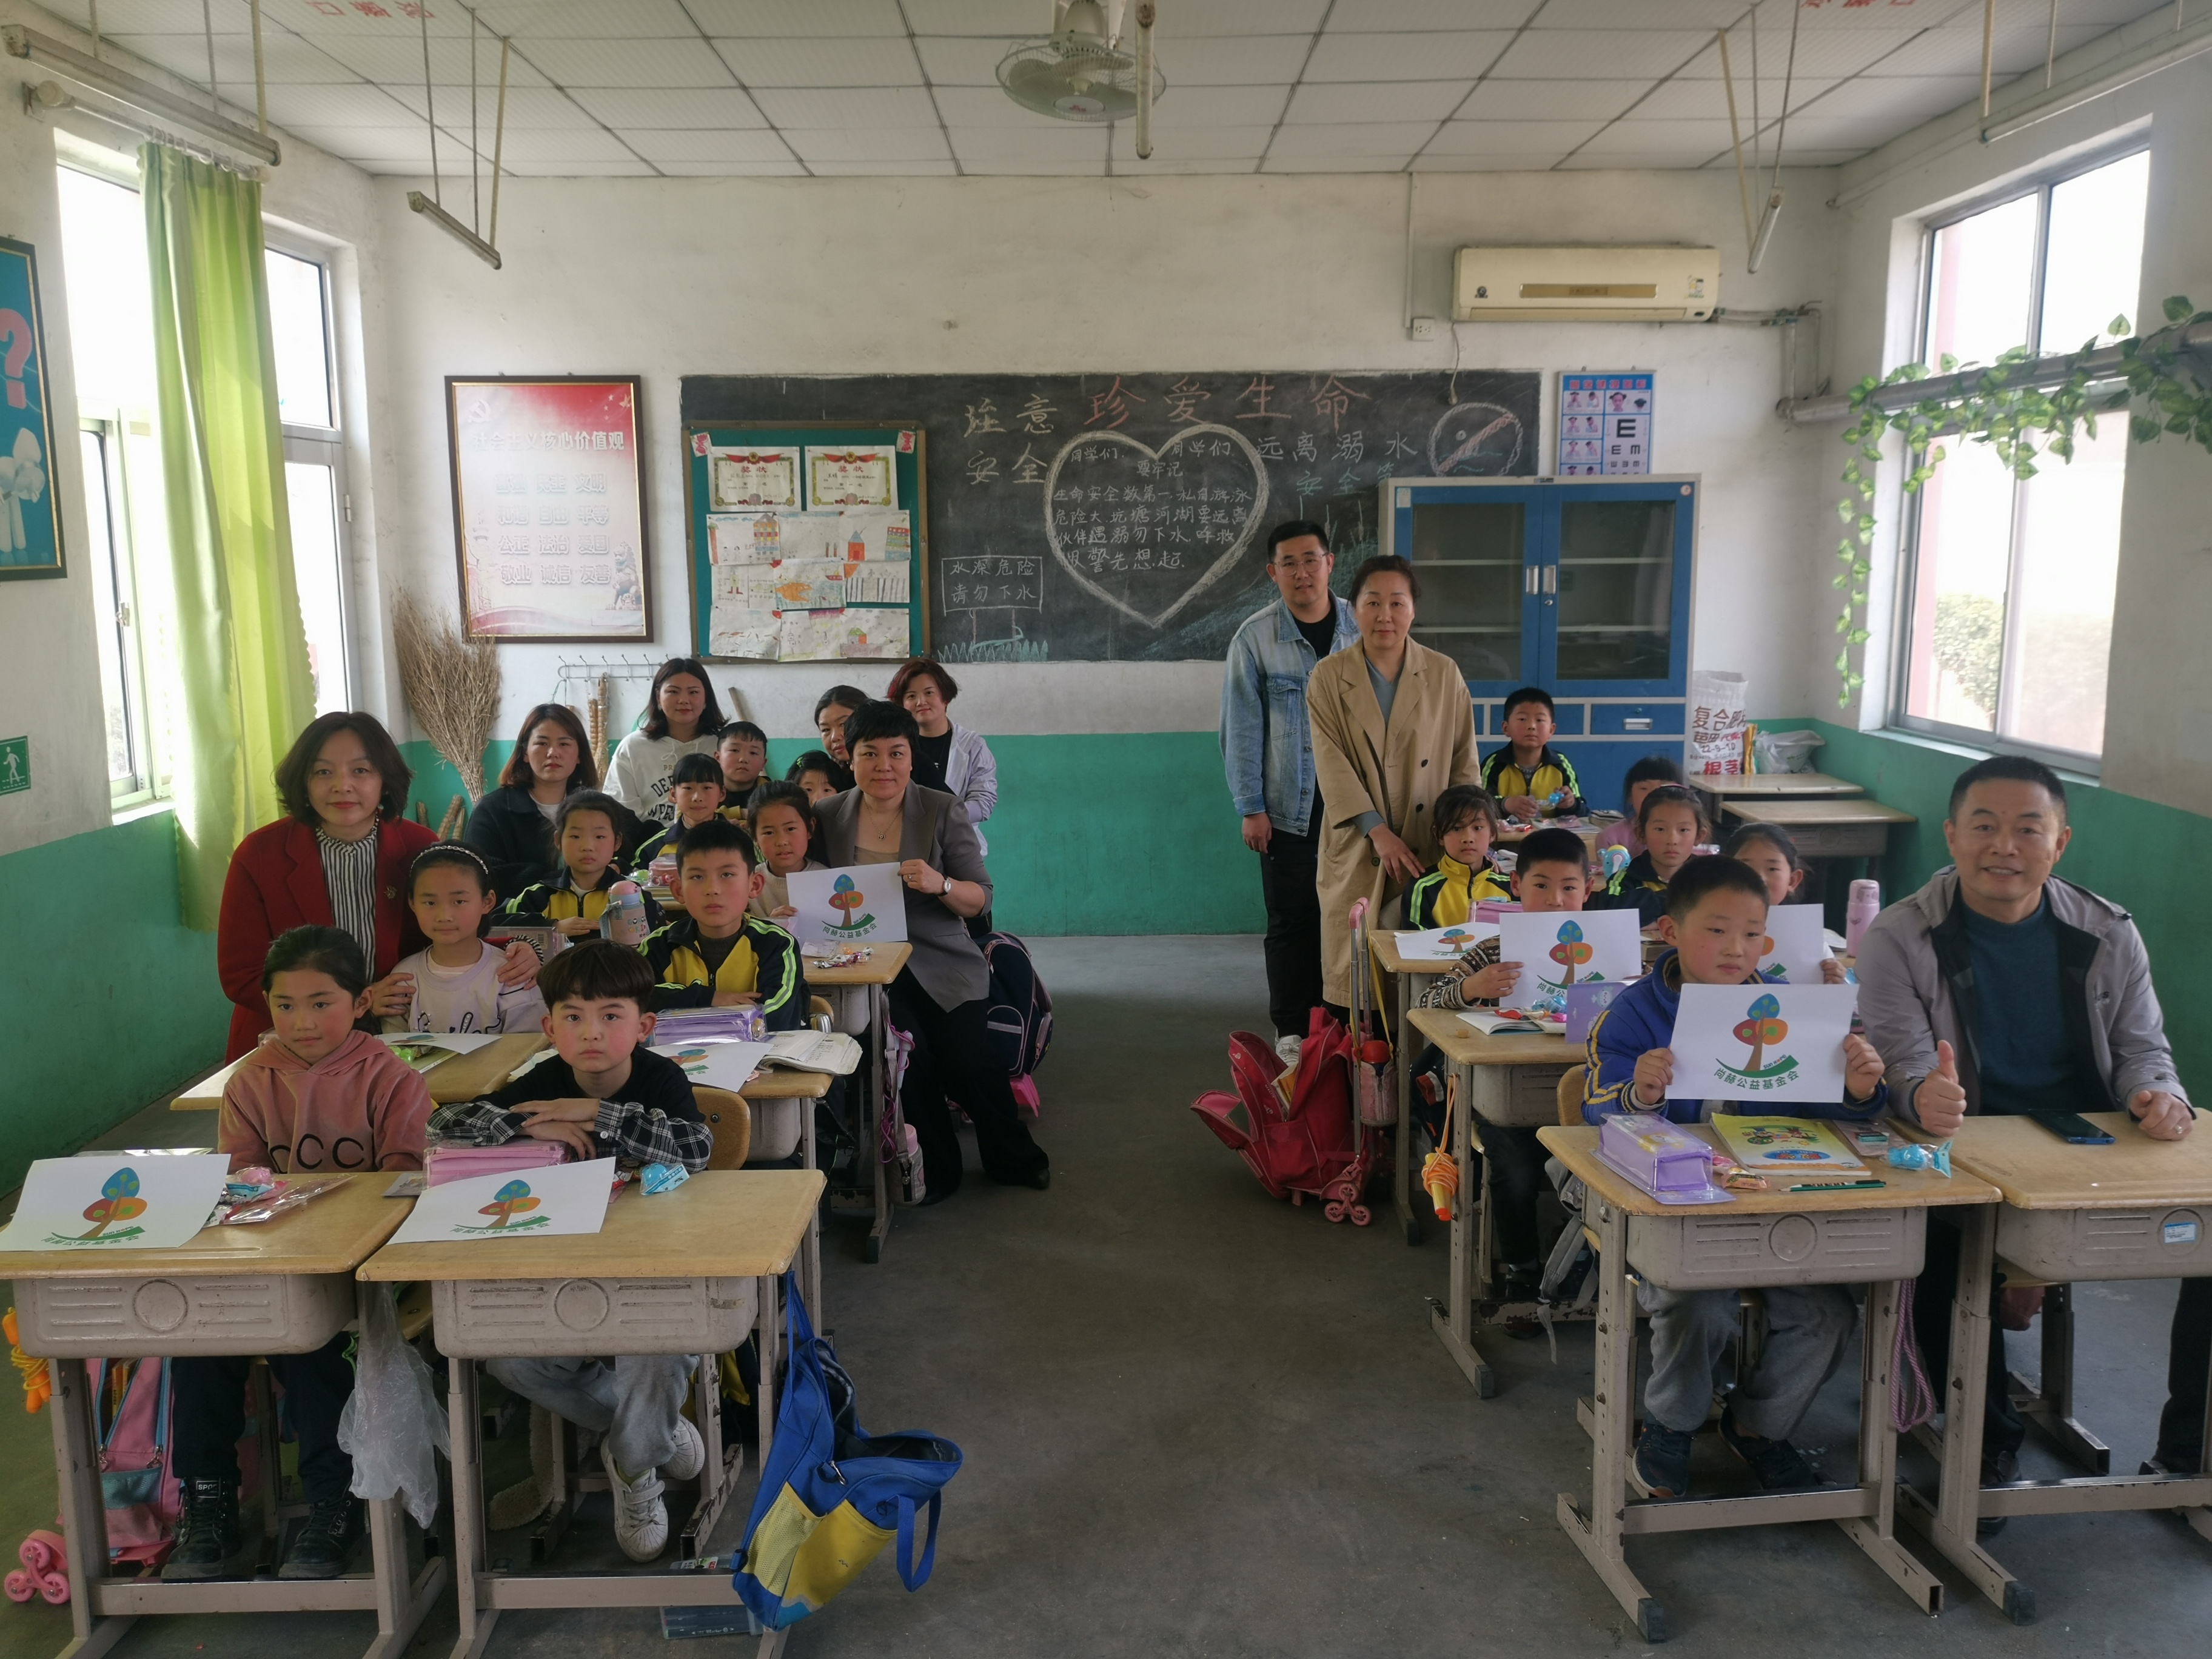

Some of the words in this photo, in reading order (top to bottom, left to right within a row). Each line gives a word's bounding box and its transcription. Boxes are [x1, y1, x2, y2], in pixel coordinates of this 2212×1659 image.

[1084, 375, 1371, 433] 珍爱生命
[473, 431, 625, 451] 社会主义核心价值观
[1257, 431, 1418, 463] 远离溺水
[965, 442, 1047, 484] 安全
[1137, 459, 1183, 479] 要牢记
[537, 473, 566, 492] 民主
[575, 472, 607, 492] 文明
[497, 504, 529, 525] 和谐
[539, 504, 569, 525] 自由
[578, 504, 609, 525] 平等
[498, 535, 529, 555] 公正
[538, 535, 569, 555] 法治
[578, 534, 609, 554] 爱国
[501, 565, 532, 585] 敬业
[540, 565, 571, 585] 诚信
[580, 564, 611, 585] 友善
[950, 558, 1036, 576] 水深危险
[951, 584, 1037, 604] 请勿下水
[1701, 743, 1736, 753] 22-9-10
[822, 922, 877, 939] 尚赫公益基金会
[1714, 1067, 1800, 1090] 尚赫公益基金会
